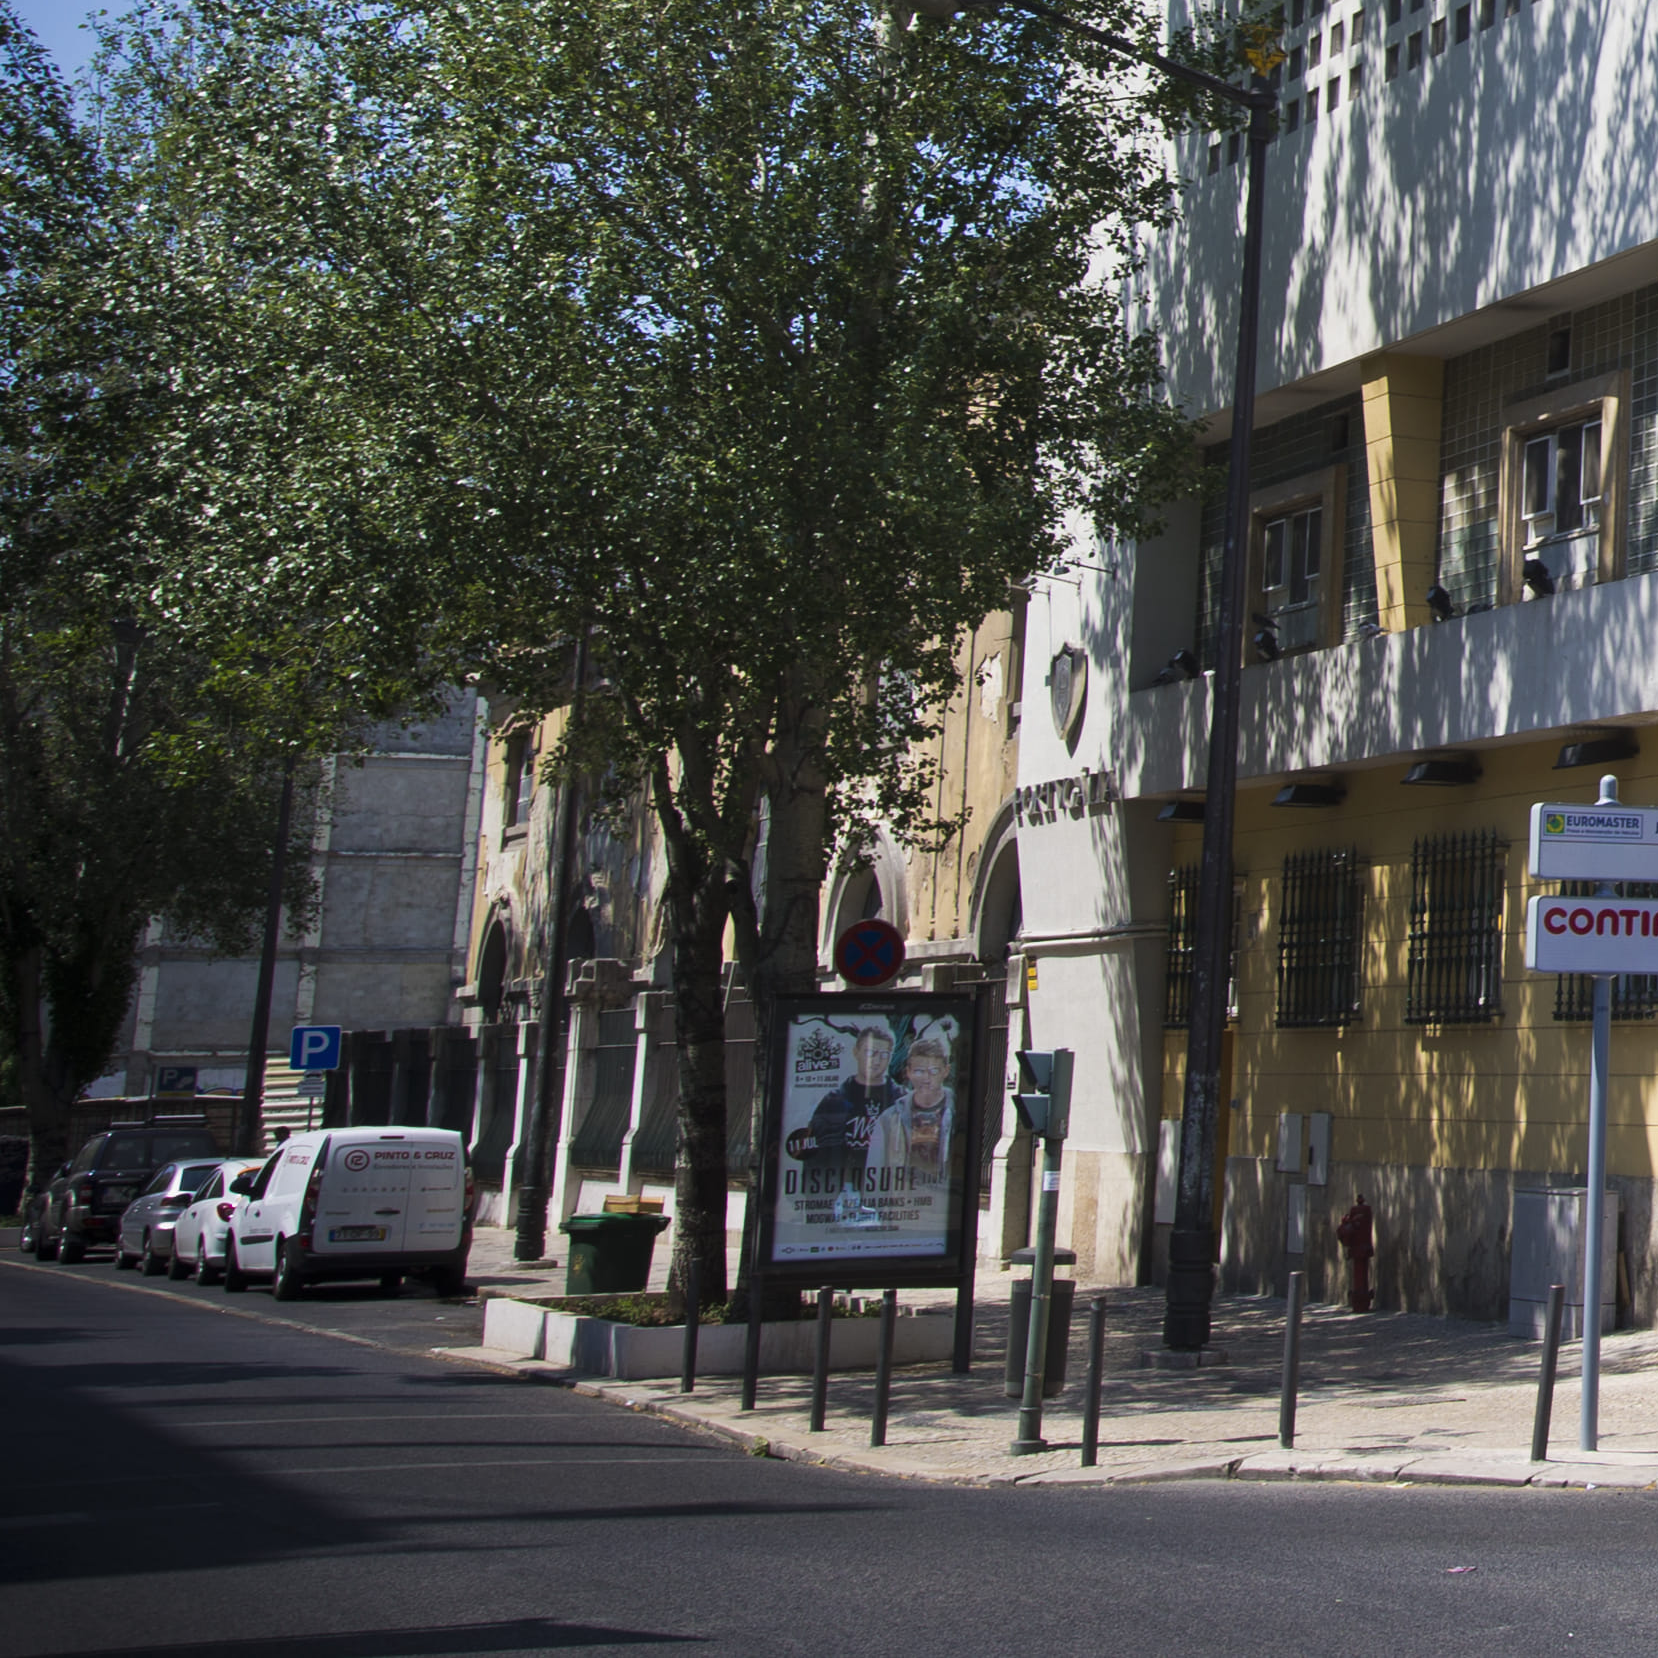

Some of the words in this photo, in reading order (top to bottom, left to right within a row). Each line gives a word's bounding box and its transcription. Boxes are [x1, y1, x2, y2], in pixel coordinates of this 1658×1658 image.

[1566, 815, 1640, 829] EUROMASTER
[300, 1030, 330, 1066] P
[789, 1139, 801, 1153] 11
[802, 1136, 820, 1150] JUL
[374, 1151, 410, 1160] PINTO
[413, 1151, 422, 1160] &
[425, 1151, 455, 1160] CRUZ
[785, 1165, 917, 1195] DISCLOSURE
[794, 1198, 833, 1211] STROMAE
[878, 1196, 905, 1208] BANKS
[878, 1209, 919, 1221] FACILITIES
